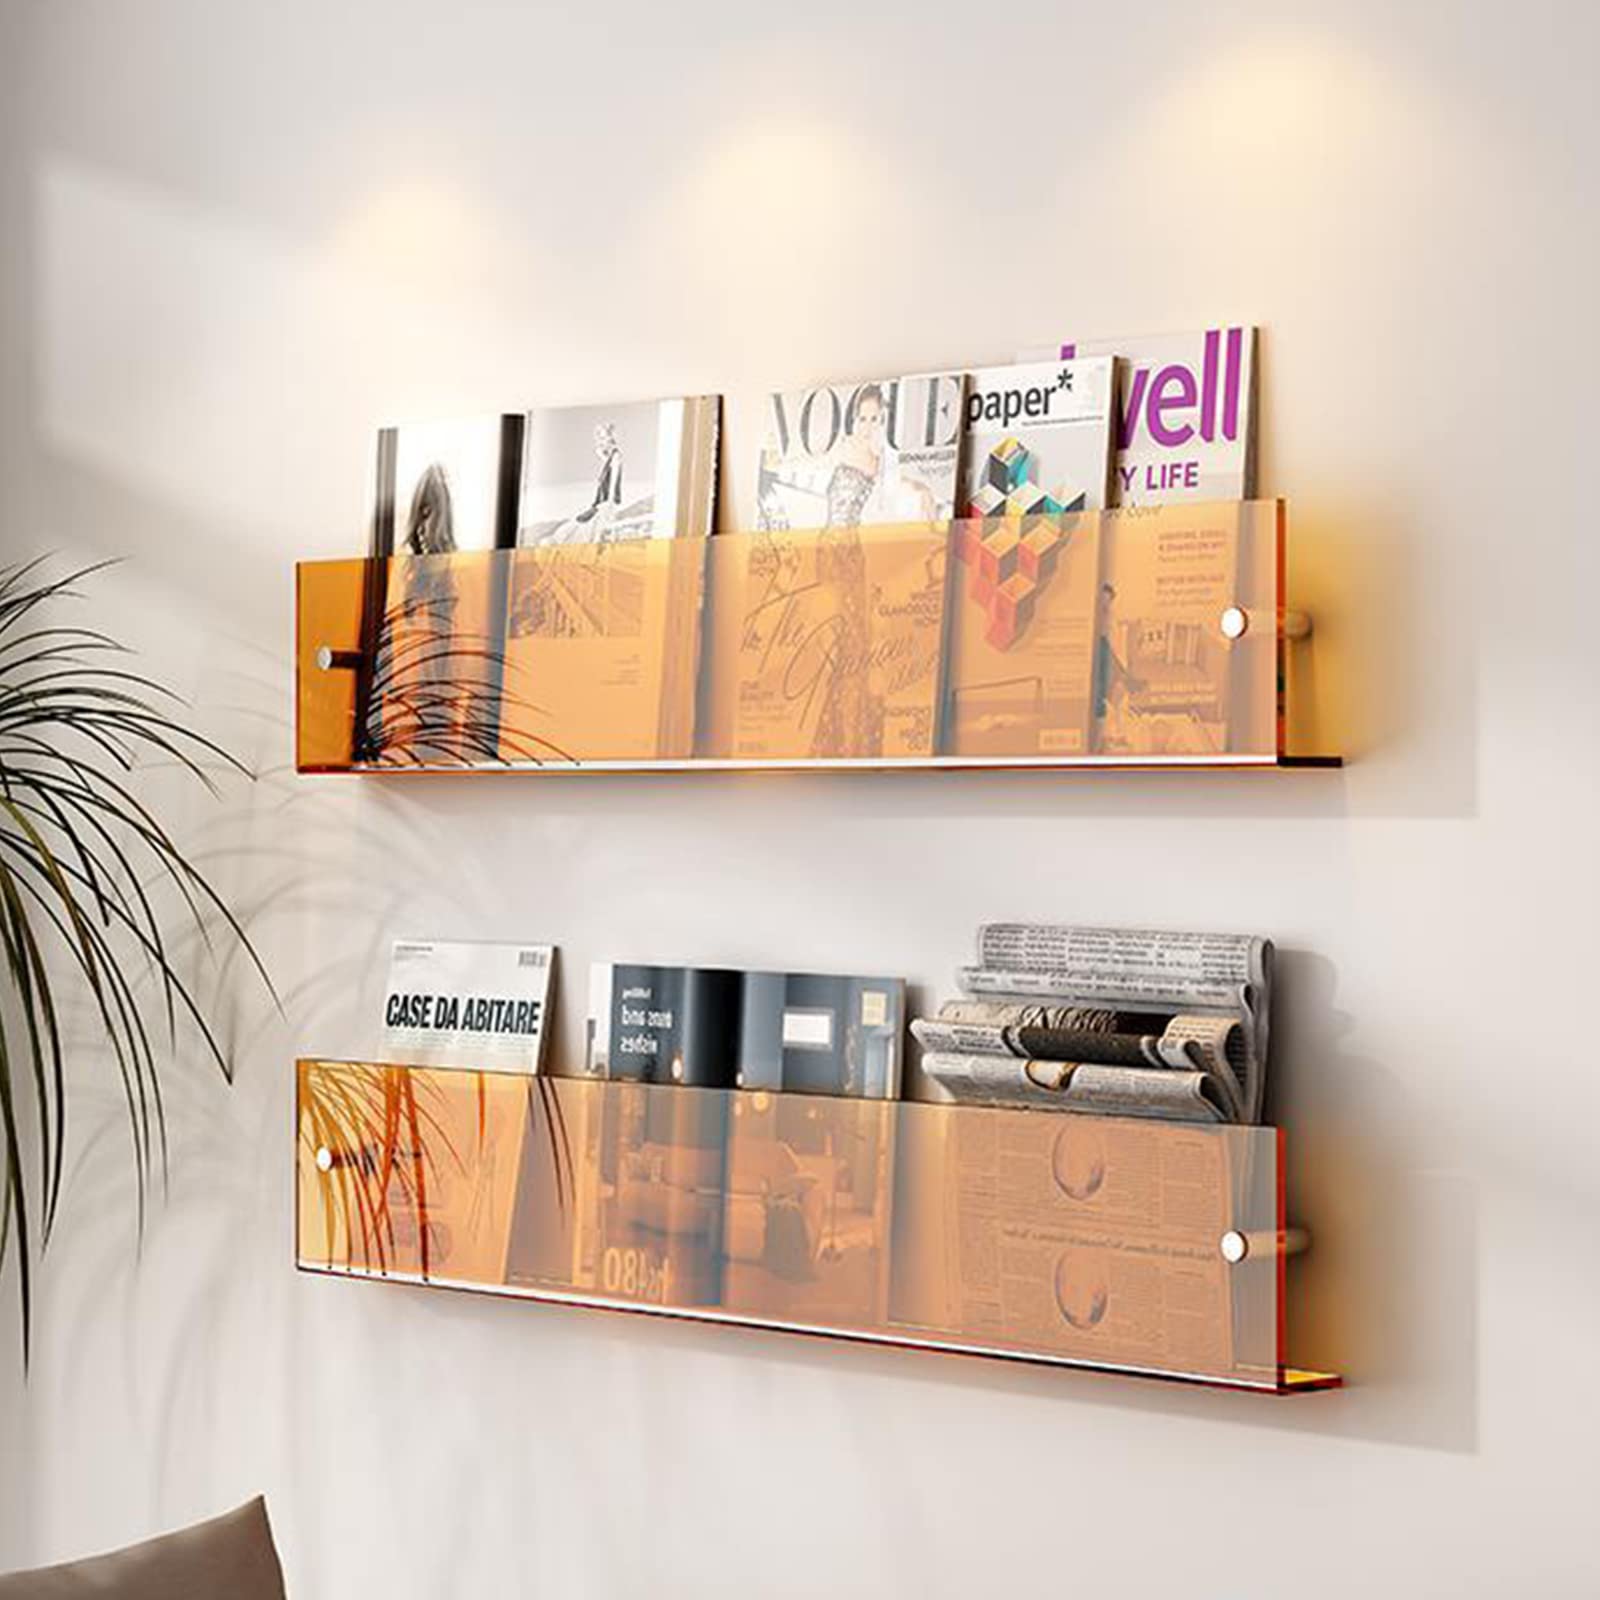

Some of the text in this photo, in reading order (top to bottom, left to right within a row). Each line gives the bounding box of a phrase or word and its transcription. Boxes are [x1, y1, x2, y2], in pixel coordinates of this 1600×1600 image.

[1146, 461, 1199, 490] LIFE
[386, 994, 541, 1034] CASE DA ABITARE
